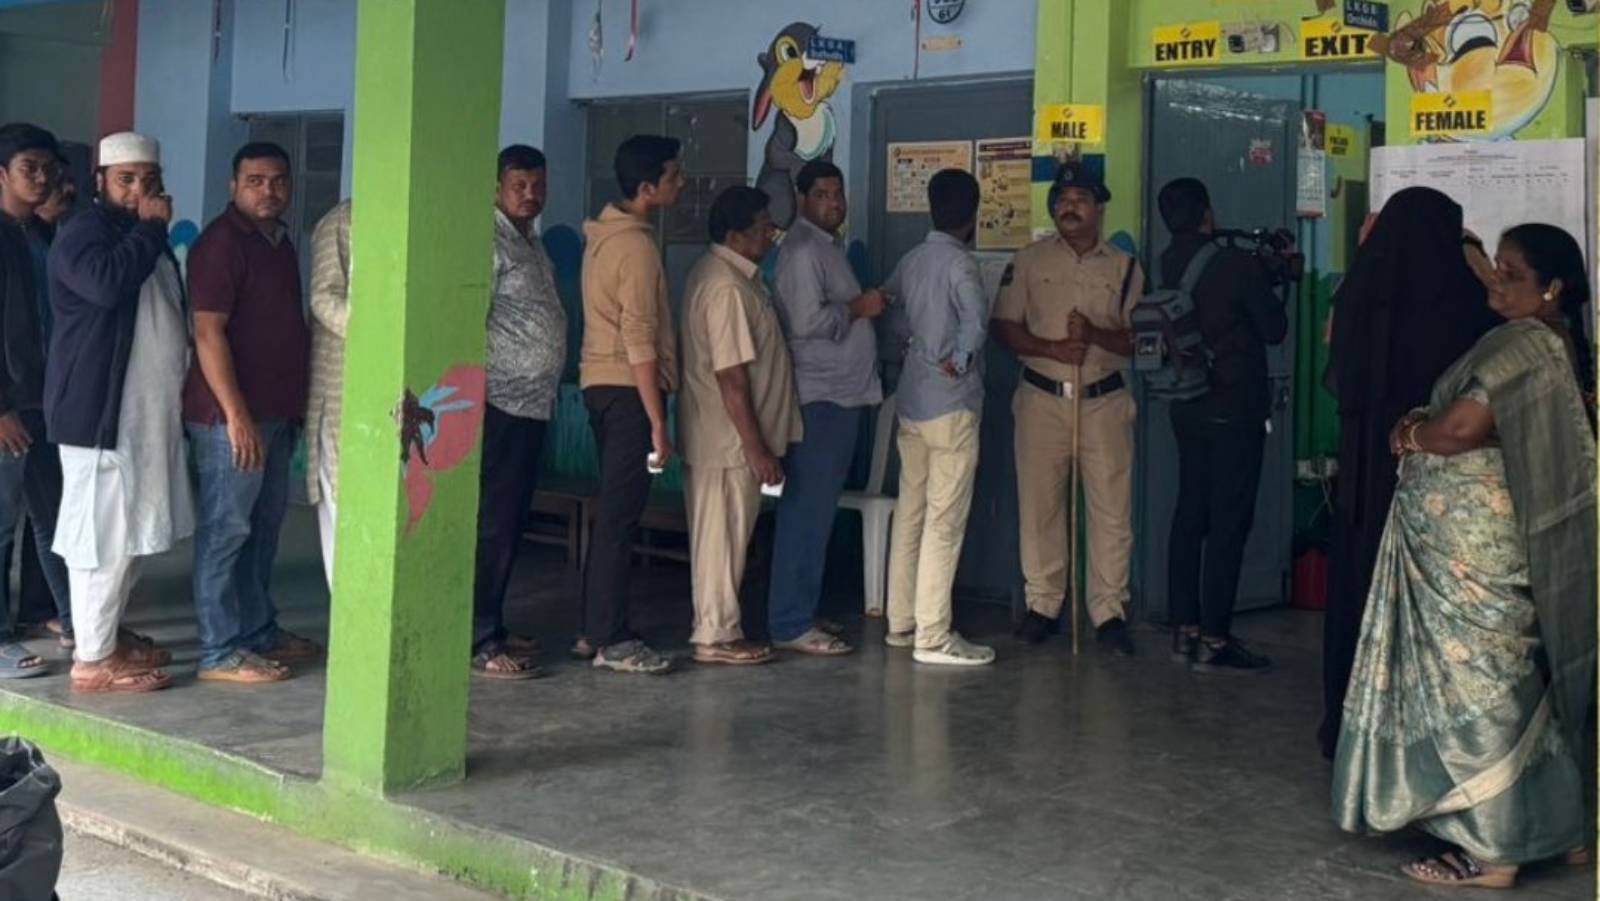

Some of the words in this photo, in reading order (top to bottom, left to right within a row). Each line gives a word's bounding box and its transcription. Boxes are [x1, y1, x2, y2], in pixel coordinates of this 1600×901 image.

[1155, 38, 1216, 61] ENTRY
[1304, 34, 1369, 57] EXIT
[1051, 121, 1087, 139] MALE
[1415, 110, 1486, 131] FEMALE
